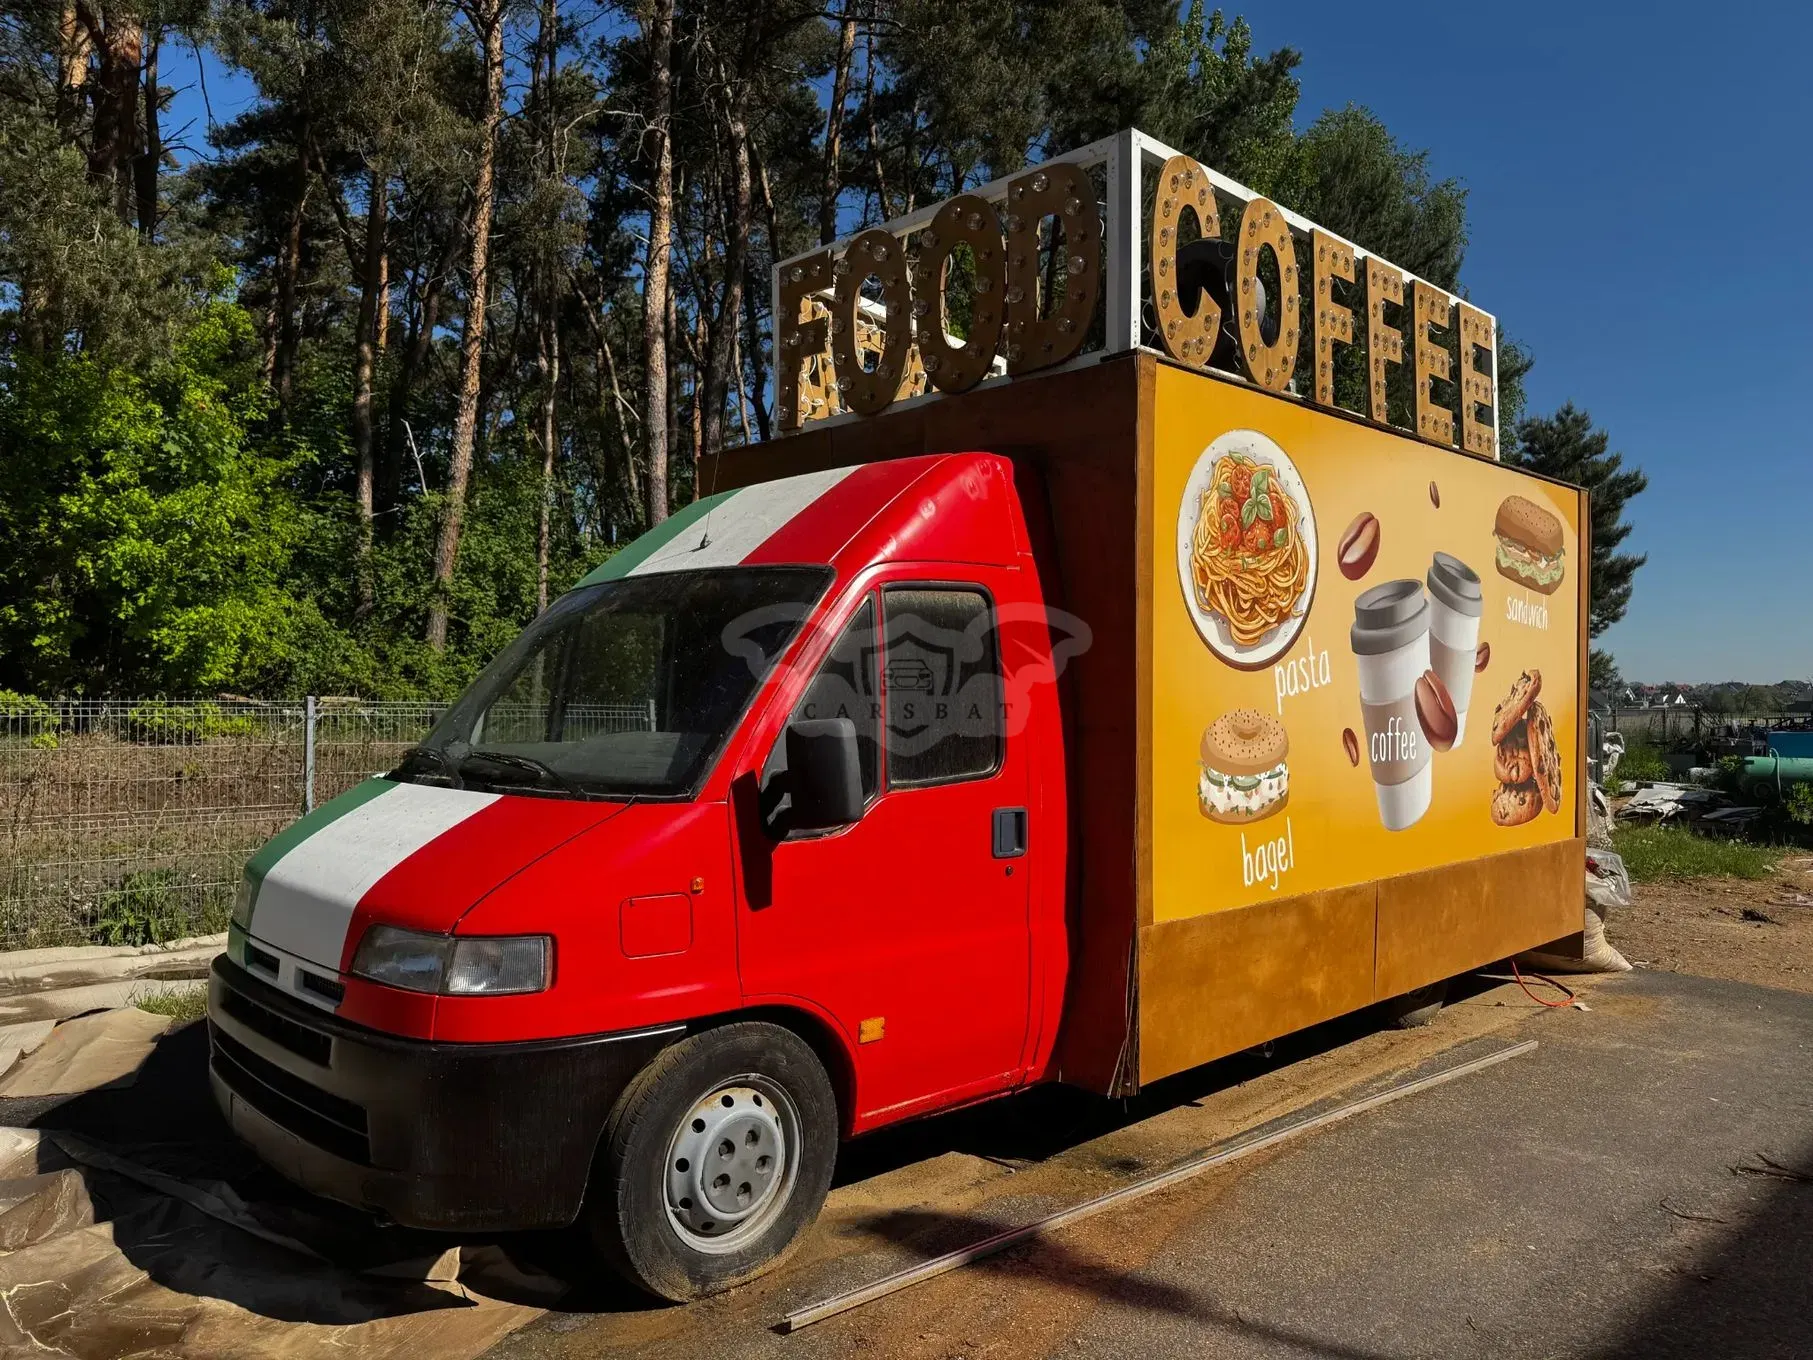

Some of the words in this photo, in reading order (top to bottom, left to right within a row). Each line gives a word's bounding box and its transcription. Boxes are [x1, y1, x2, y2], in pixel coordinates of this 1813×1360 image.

[778, 163, 1100, 430] FOOD
[1151, 155, 1494, 457] COFFEE
[1506, 589, 1548, 631] sandwich
[1274, 636, 1332, 713] pasta
[1371, 716, 1417, 761] coffee
[1241, 817, 1295, 890] bagel
